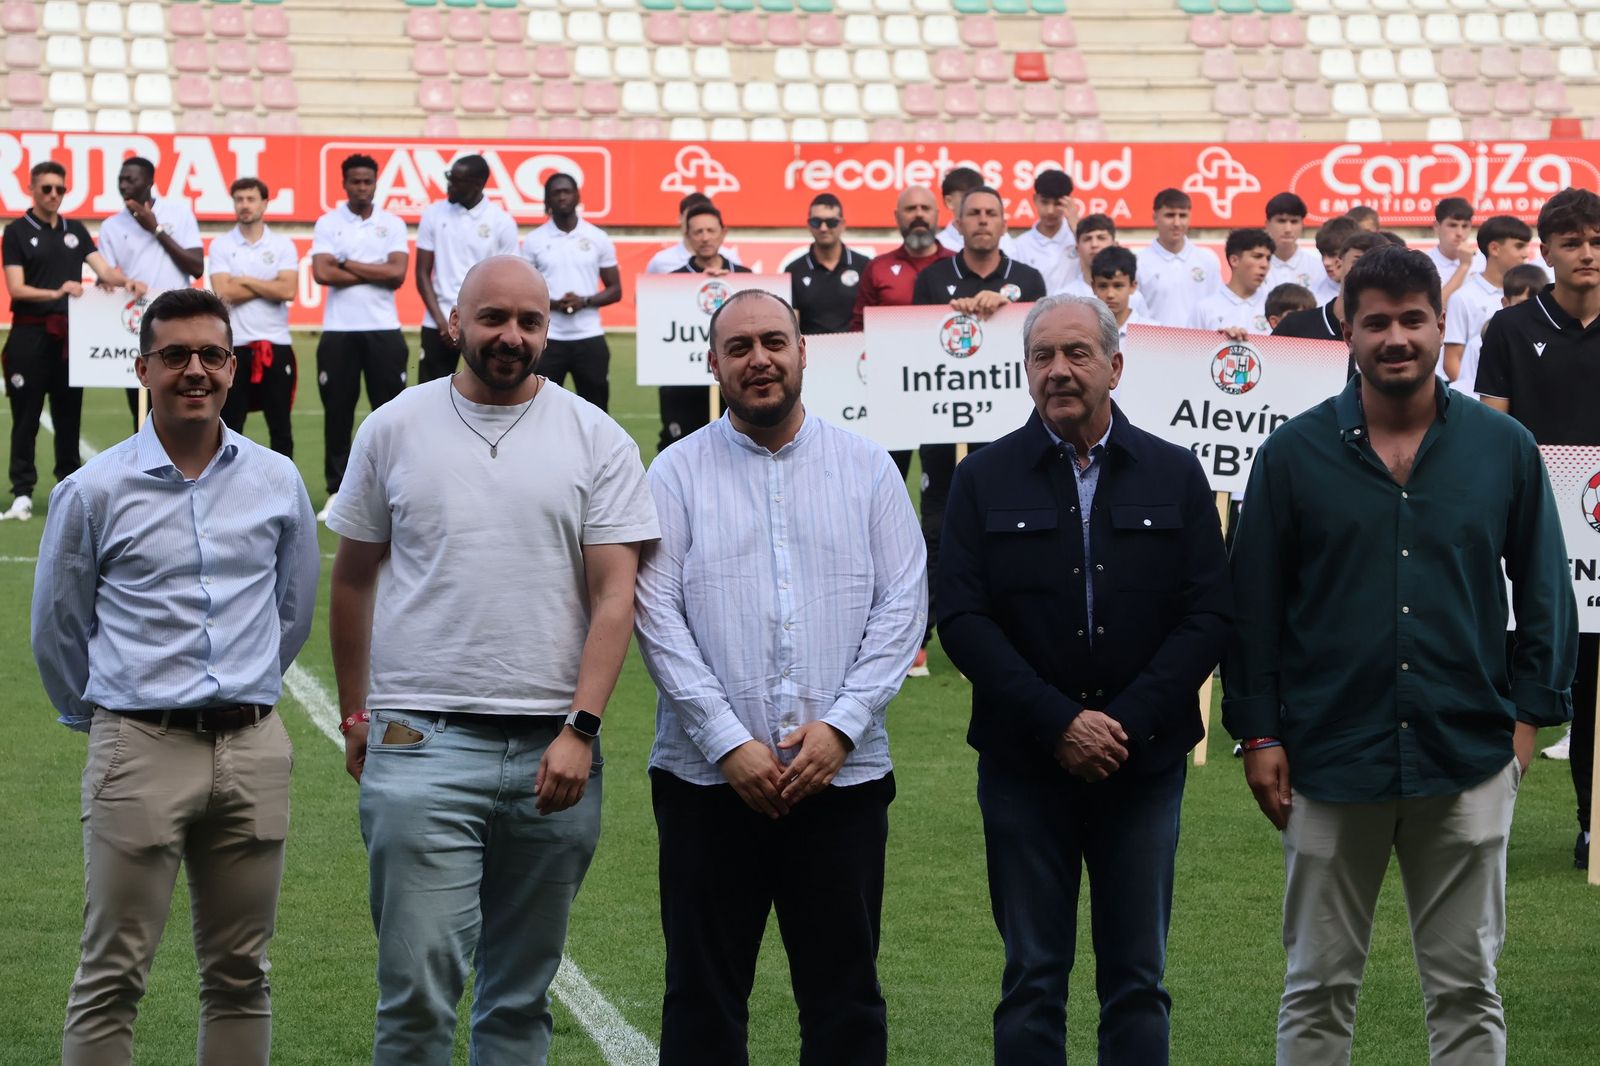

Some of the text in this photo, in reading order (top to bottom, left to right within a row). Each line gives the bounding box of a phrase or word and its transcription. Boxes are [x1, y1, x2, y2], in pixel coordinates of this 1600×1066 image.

[784, 146, 1003, 191] recolets
[1320, 198, 1438, 213] EMBUTIDO
[903, 361, 1021, 392] Infantil
[932, 401, 992, 428] “B”
